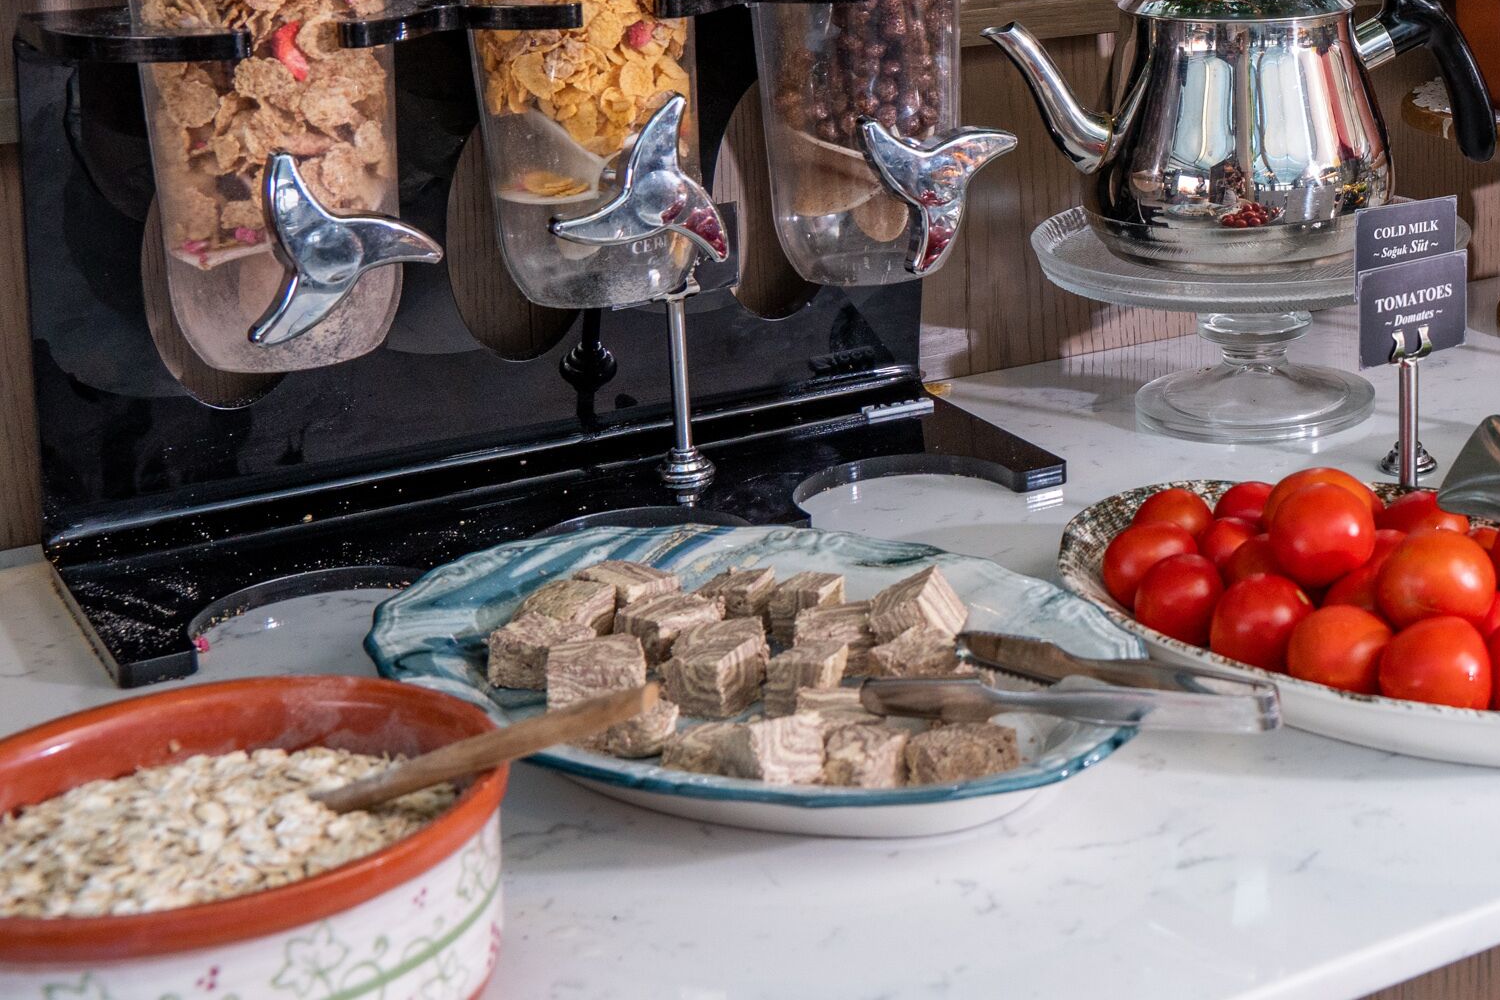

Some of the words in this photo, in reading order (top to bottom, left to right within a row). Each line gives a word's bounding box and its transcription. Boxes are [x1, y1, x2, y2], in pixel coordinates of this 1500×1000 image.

[1373, 224, 1407, 240] COLD
[1408, 219, 1439, 235] MILK
[1380, 245, 1408, 260] Soğuk
[1409, 238, 1429, 254] Süt
[1374, 283, 1453, 313] TOMATOES
[1394, 308, 1435, 327] Domates
